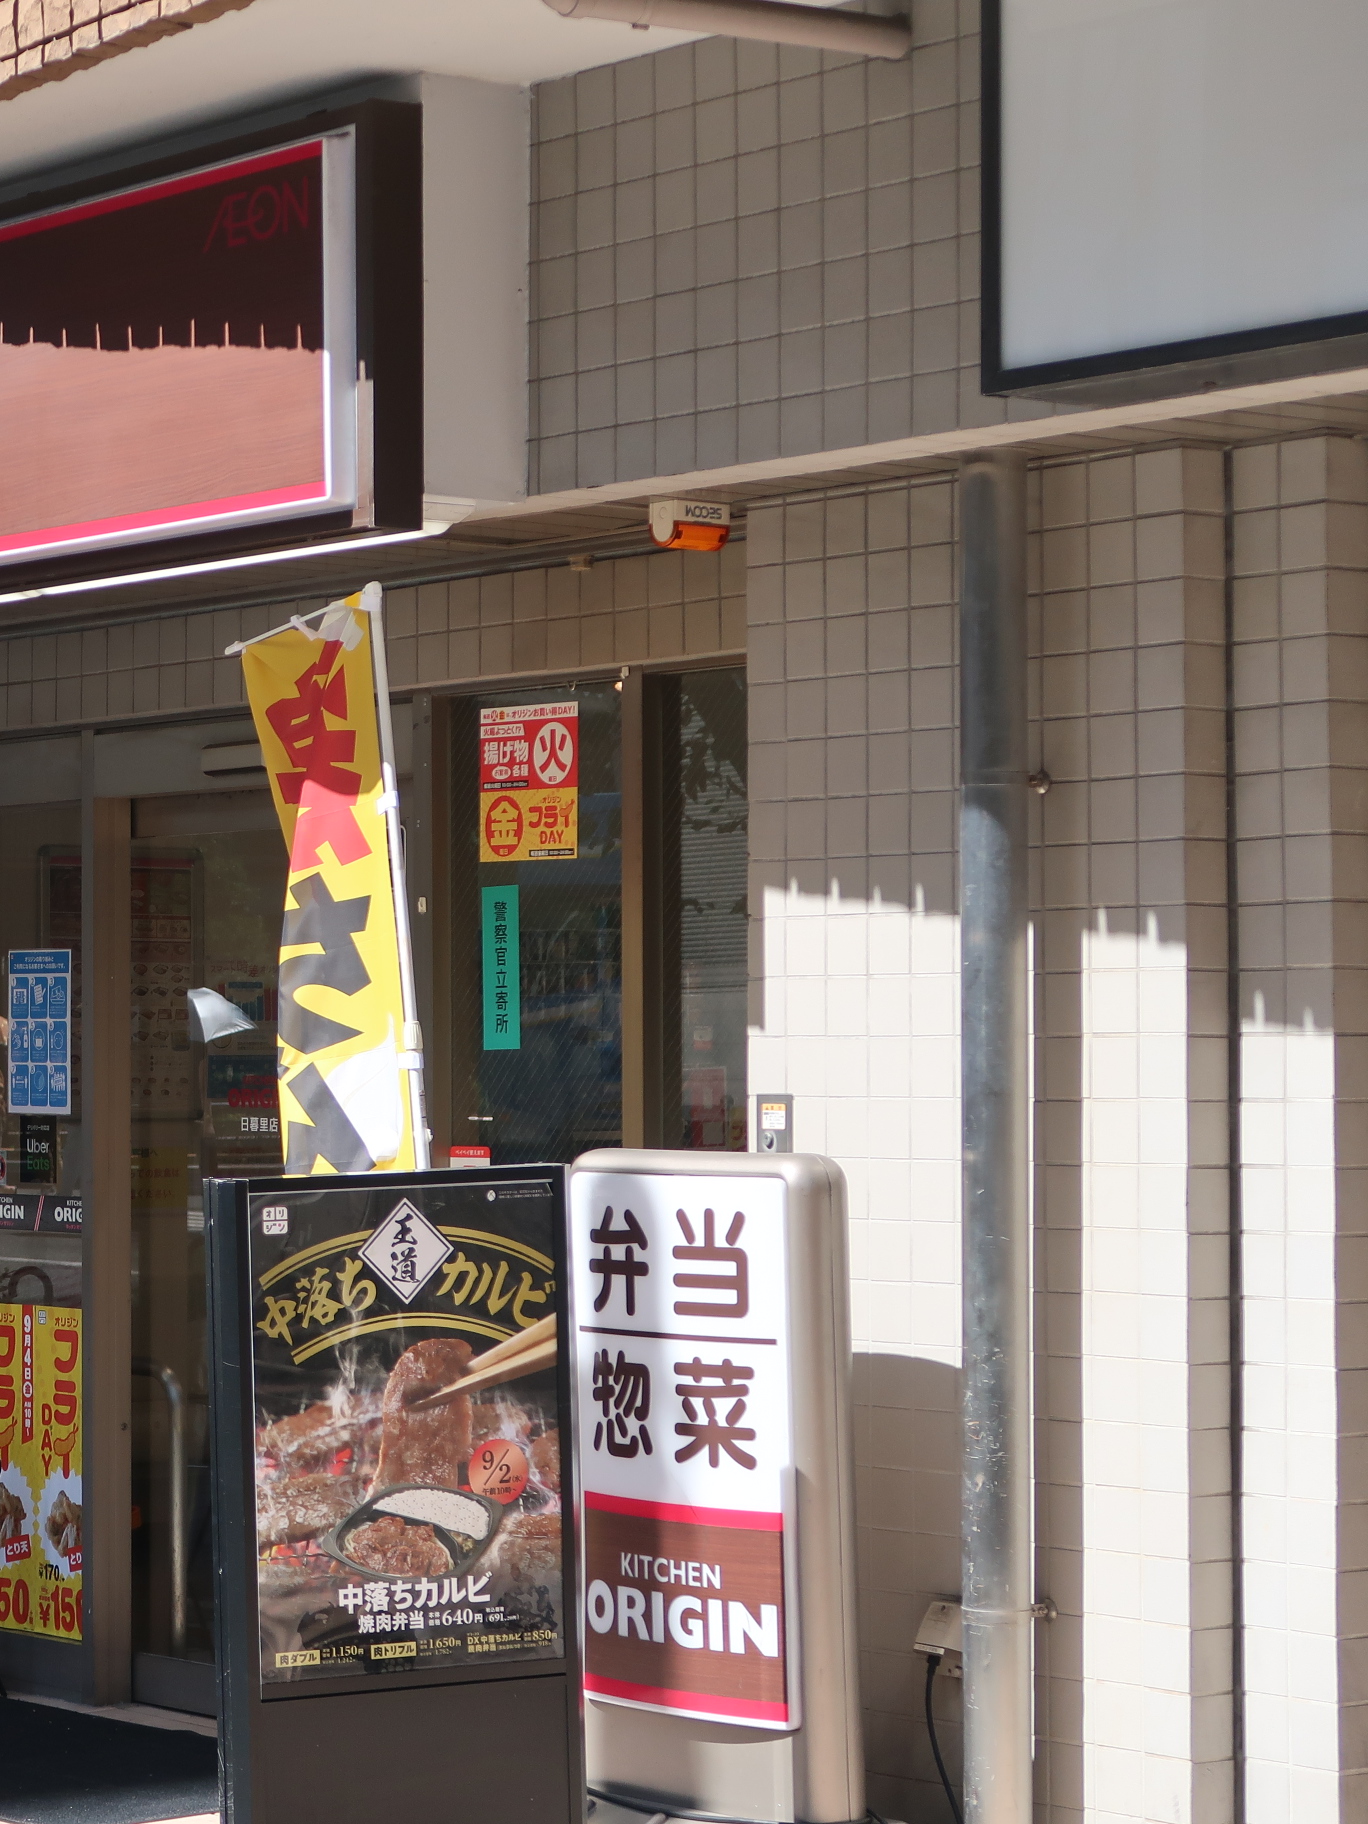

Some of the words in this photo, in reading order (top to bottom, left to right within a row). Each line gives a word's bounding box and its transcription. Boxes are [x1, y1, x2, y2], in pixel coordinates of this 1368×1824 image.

[484, 739, 529, 765] 揚げ物
[539, 728, 568, 774] 火
[490, 801, 519, 846] 金
[539, 830, 564, 845] DAY
[493, 900, 510, 1034] 警察官立寄所
[241, 1117, 278, 1132] 日暮里店
[27, 1138, 50, 1153] Uber
[27, 1156, 50, 1171] Eats
[54, 1206, 83, 1223] ORIG
[589, 1205, 749, 1320] 弁当
[257, 1256, 376, 1345] 中落ち
[437, 1253, 557, 1327] カルビ
[590, 1348, 758, 1471] 惣菜
[41, 1403, 53, 1477] DAY
[6, 1541, 29, 1557] とり天
[70, 1552, 82, 1564] とり
[620, 1552, 722, 1590] KITCHEN
[338, 1571, 492, 1616] 中落ちカルビ
[358, 1610, 424, 1634] 焼肉弁当
[587, 1578, 780, 1658] ORIGIN
